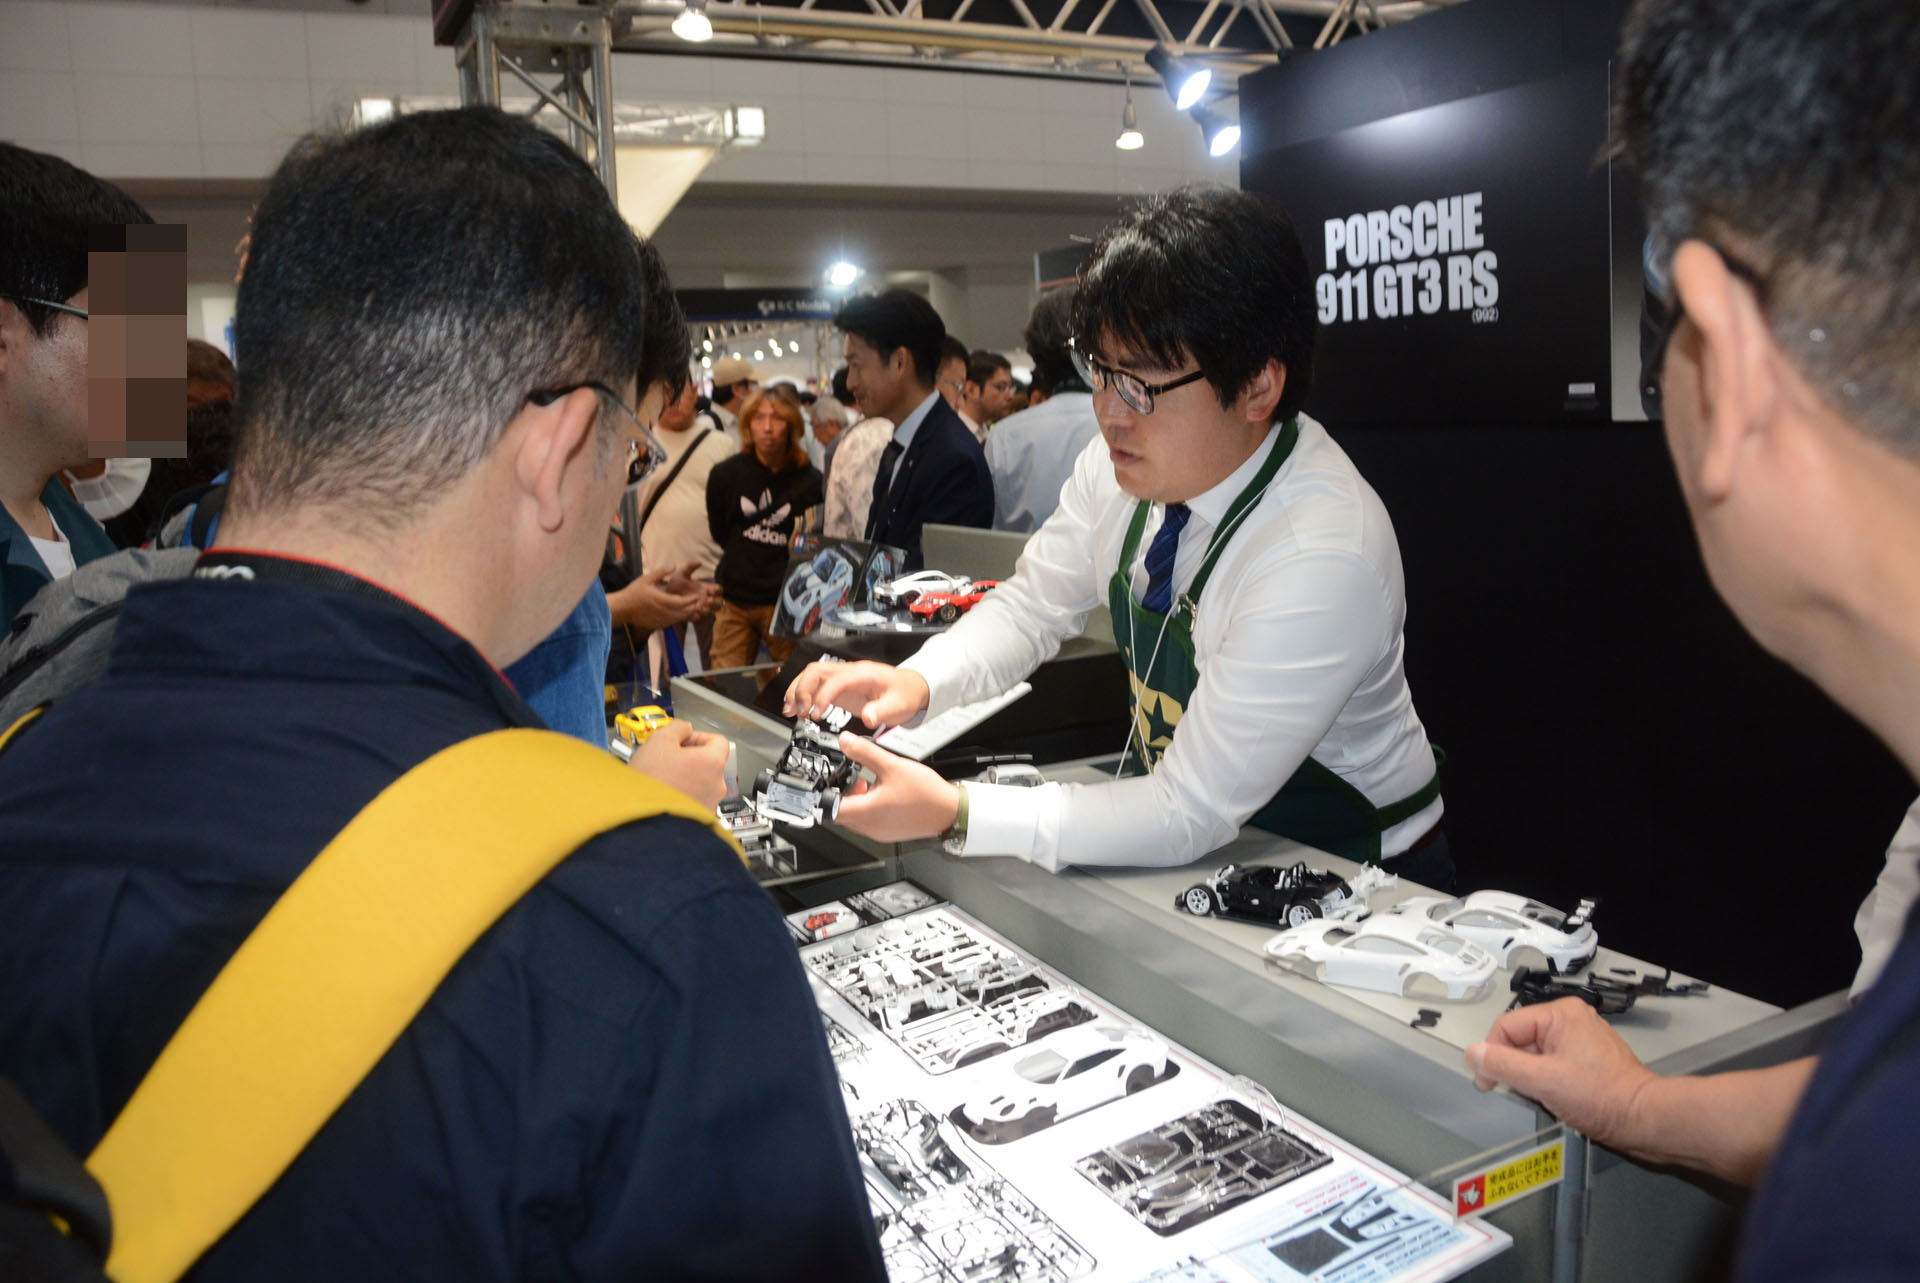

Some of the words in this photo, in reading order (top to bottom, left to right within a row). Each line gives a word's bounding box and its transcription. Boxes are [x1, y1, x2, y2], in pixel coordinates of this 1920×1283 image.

[1324, 191, 1484, 271] PORSCHE
[1316, 268, 1369, 325] 911
[1373, 258, 1442, 319] GT3
[1447, 250, 1499, 311] RS
